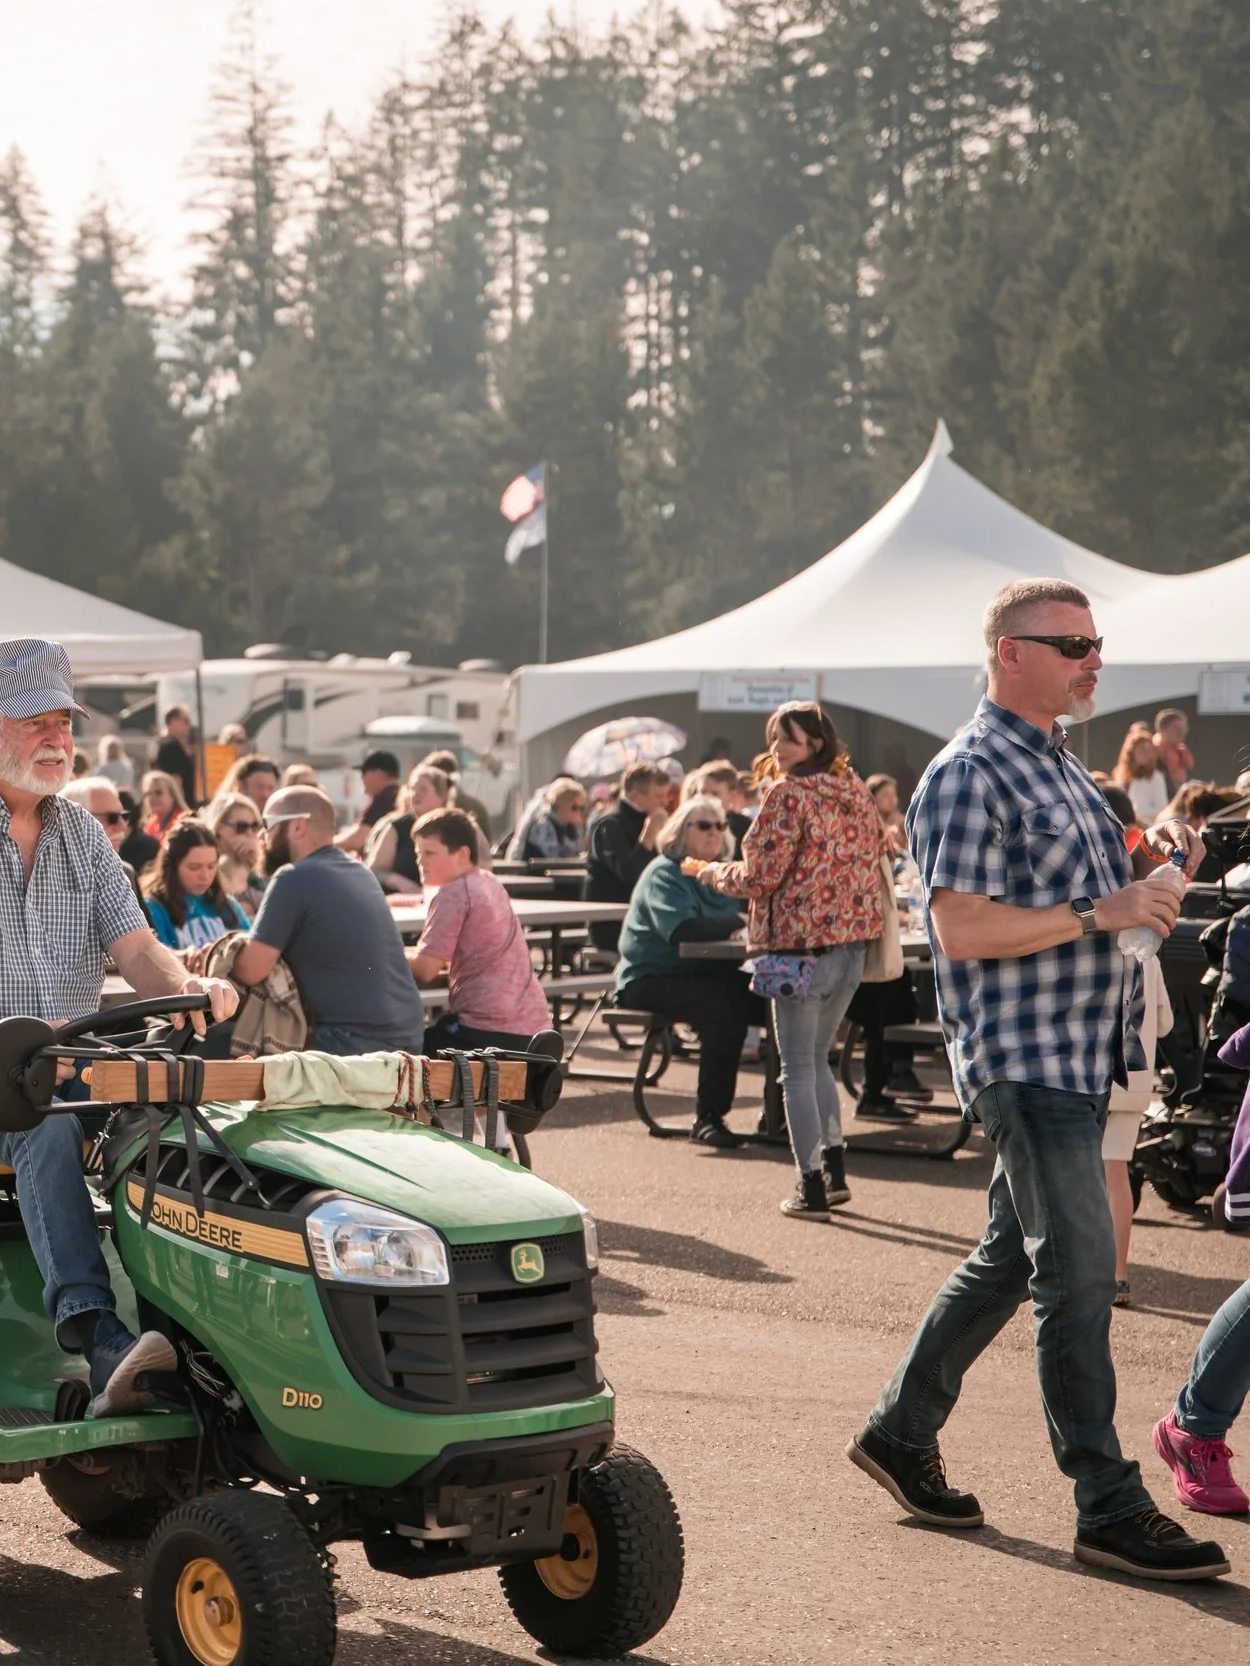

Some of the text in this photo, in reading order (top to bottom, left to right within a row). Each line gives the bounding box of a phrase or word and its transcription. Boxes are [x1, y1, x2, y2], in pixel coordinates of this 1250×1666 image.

[151, 1202, 242, 1250] OHN DEERE
[282, 1386, 323, 1410] D110
